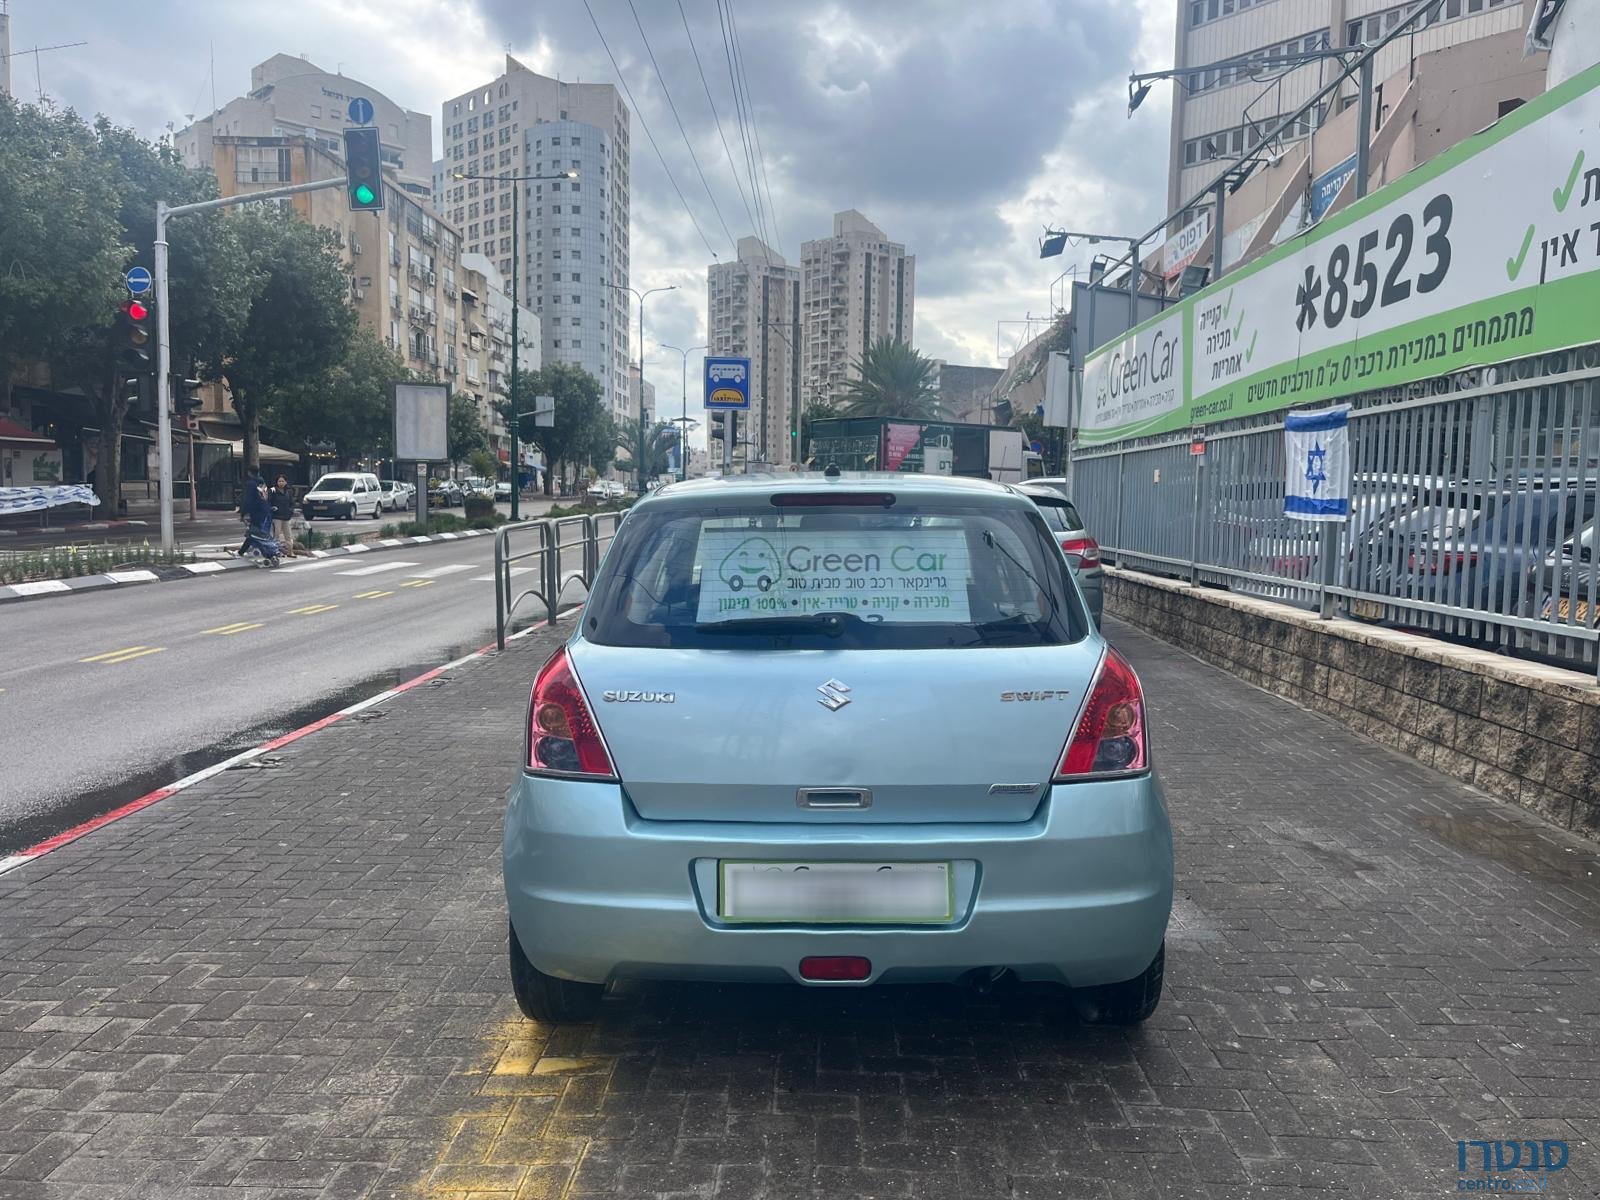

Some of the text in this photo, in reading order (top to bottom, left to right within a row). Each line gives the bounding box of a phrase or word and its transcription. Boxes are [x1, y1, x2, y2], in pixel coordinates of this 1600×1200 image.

[1180, 221, 1202, 250] דפוס
[1540, 228, 1580, 285] אין
[1199, 304, 1222, 331] קנייה
[1452, 306, 1534, 353] מתמחים
[1206, 327, 1231, 355] מכירה
[1388, 332, 1446, 368] במכירת
[1110, 330, 1178, 399] Green Car
[1211, 353, 1242, 381] אחריות
[1354, 351, 1382, 378] רכבי
[1248, 379, 1277, 402] חדשים
[1280, 371, 1312, 395] ורכבים
[787, 545, 947, 572] Green Car
[787, 577, 947, 590] גרינקאר רכב טוב מבית טוב
[719, 596, 949, 612] מכירה קניה טרייד-אין 100% מימון
[603, 690, 675, 703] SUZUKI
[1000, 690, 1069, 703] SWIFT
